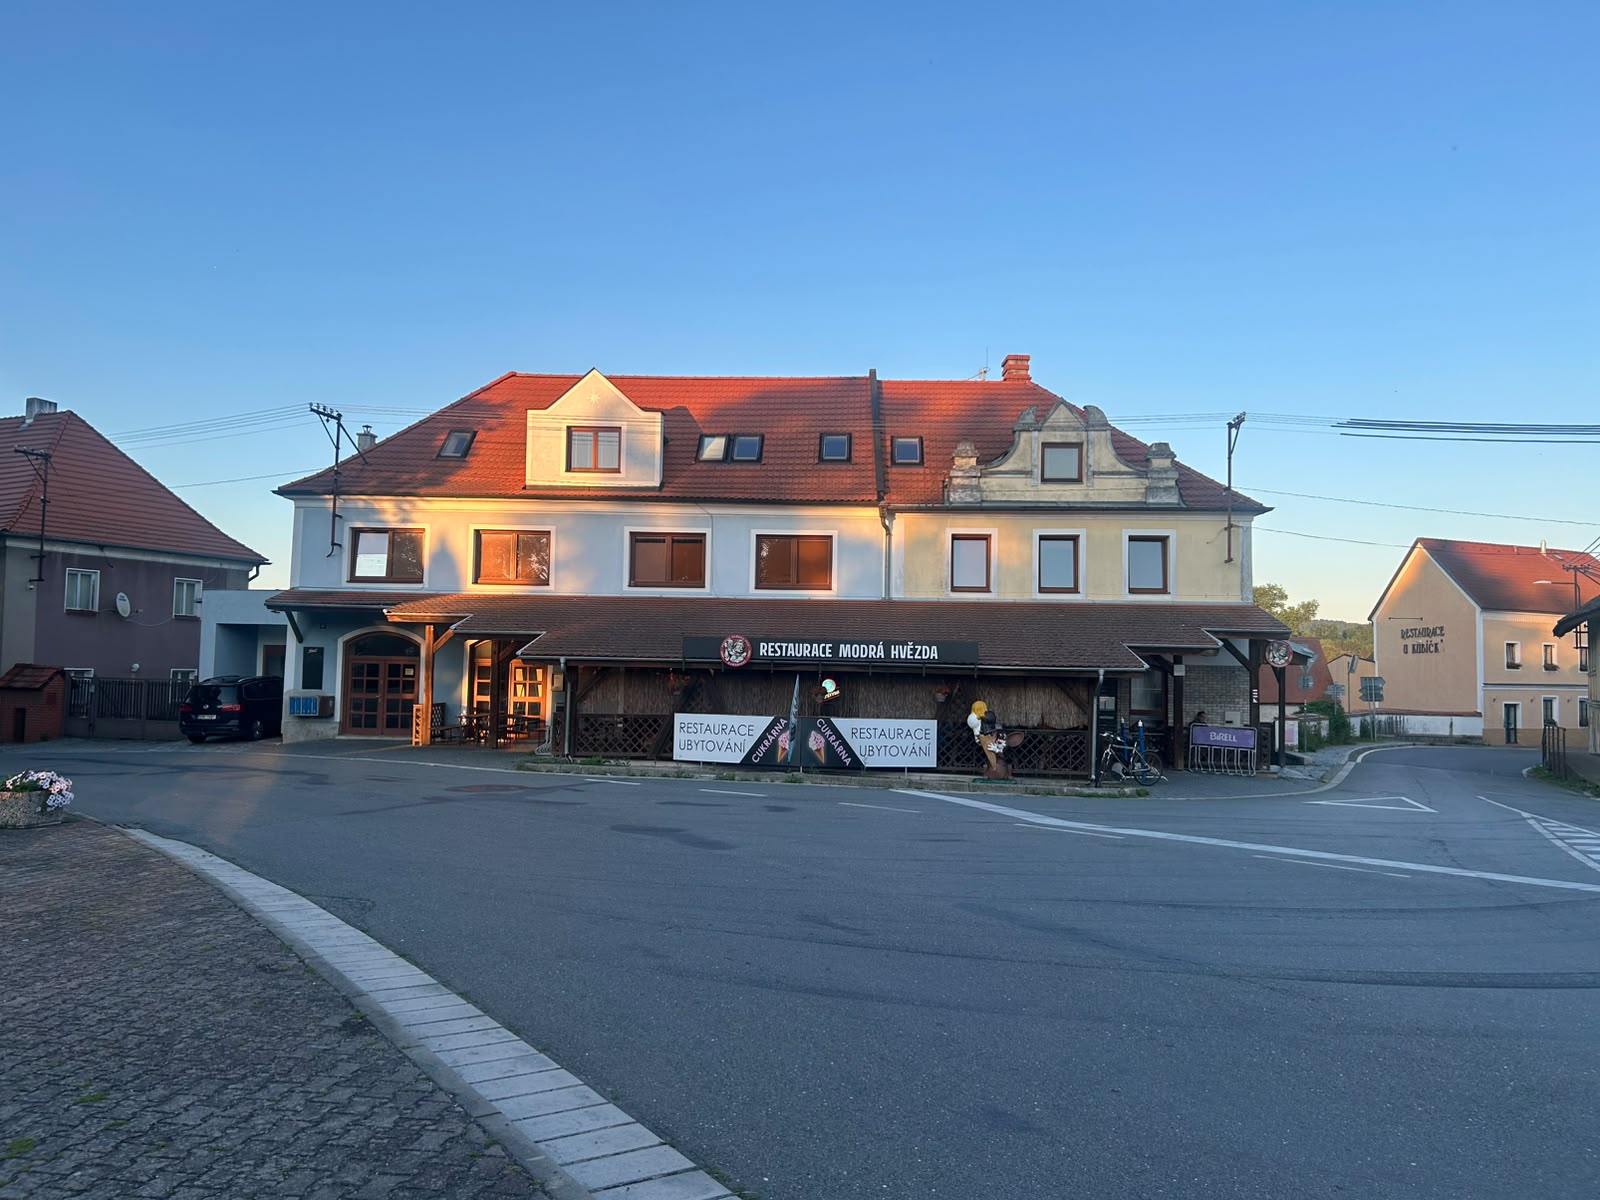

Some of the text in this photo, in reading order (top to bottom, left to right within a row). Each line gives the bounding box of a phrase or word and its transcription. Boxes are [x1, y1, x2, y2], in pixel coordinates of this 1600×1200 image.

[1401, 626, 1445, 640] RESTAURACE
[759, 642, 833, 658] RESTAURACE
[839, 641, 885, 659] MODRÁ
[891, 642, 938, 660] HVĚZDA
[679, 722, 754, 737] RESTAURACE
[851, 727, 931, 740] RESTAURACE
[678, 738, 746, 753] UBYTOVÁNÍ
[751, 718, 788, 763] CUKRÁRNA
[816, 718, 852, 766] CUKRÁRNA
[860, 742, 931, 757] UBYTOVÁNÍ
